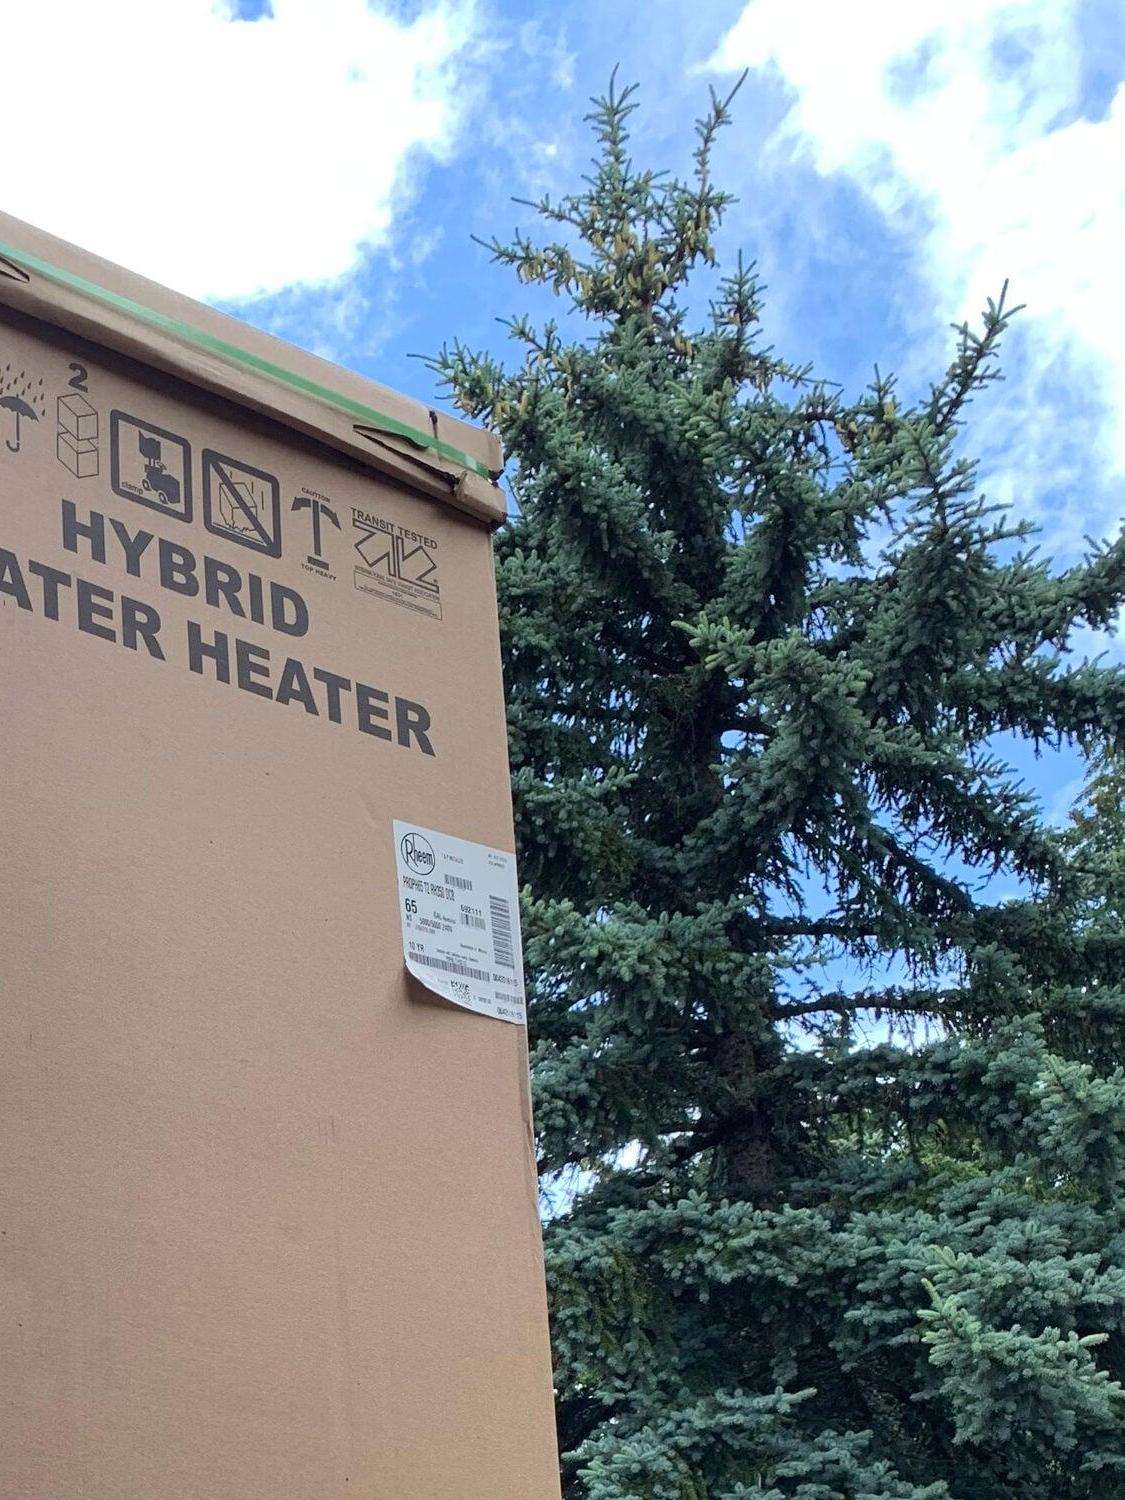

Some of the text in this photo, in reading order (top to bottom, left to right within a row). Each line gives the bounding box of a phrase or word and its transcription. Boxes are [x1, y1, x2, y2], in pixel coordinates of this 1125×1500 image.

[68, 362, 88, 393] 2
[121, 481, 144, 496] clamp
[301, 487, 331, 503] CAUTION
[350, 507, 438, 550] TRANSIT TESTED
[61, 498, 310, 638] HYBRID
[300, 563, 337, 581] TOP HEAVY
[187, 620, 437, 758] HEATER
[404, 833, 434, 867] Rheem
[404, 897, 418, 914] 65
[408, 941, 425, 953] 10 YR
